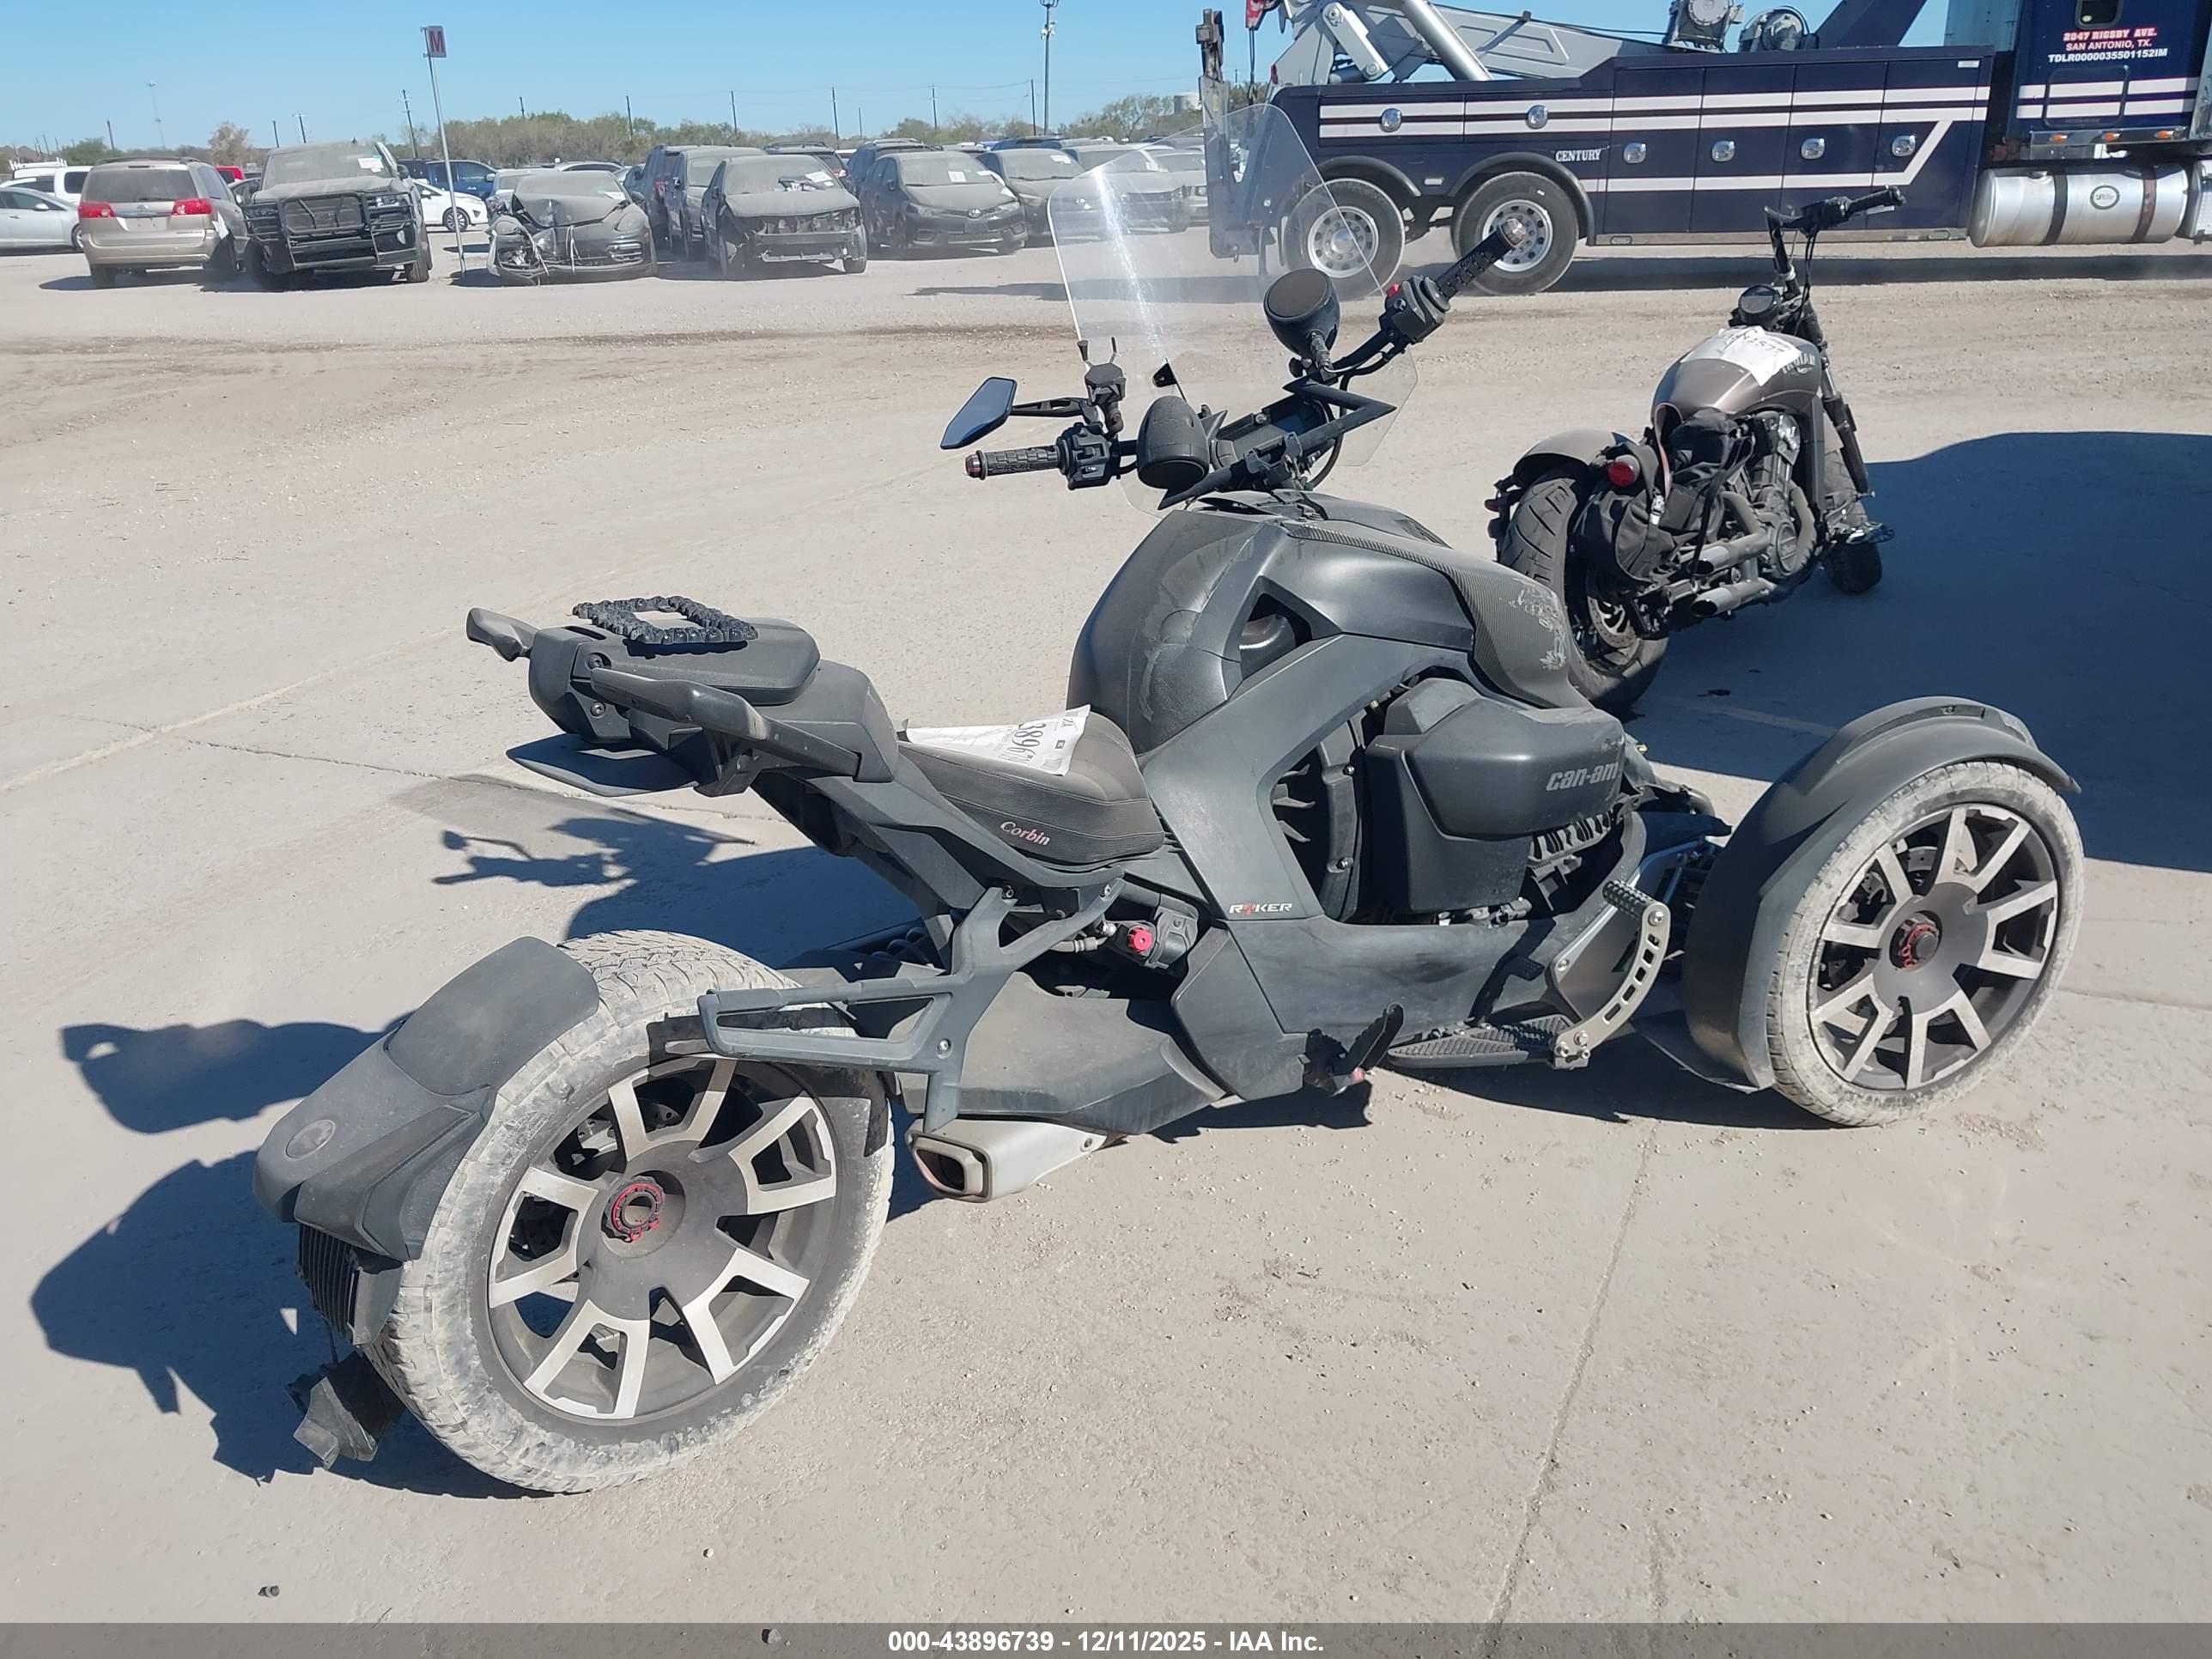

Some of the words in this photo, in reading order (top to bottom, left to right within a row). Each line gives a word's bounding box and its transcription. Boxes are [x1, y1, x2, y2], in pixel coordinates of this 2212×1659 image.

[2063, 32, 2090, 41] 2047
[2134, 27, 2158, 37] AVE.
[429, 31, 444, 52] M
[2066, 43, 2087, 52] SAN
[2087, 40, 2135, 50] ANTONIO,
[2137, 39, 2153, 47] TX.
[1555, 149, 1602, 161] CENTURY
[1546, 762, 1619, 791] can-am
[1000, 821, 1050, 846] Corbin
[1229, 902, 1292, 915] RYKER
